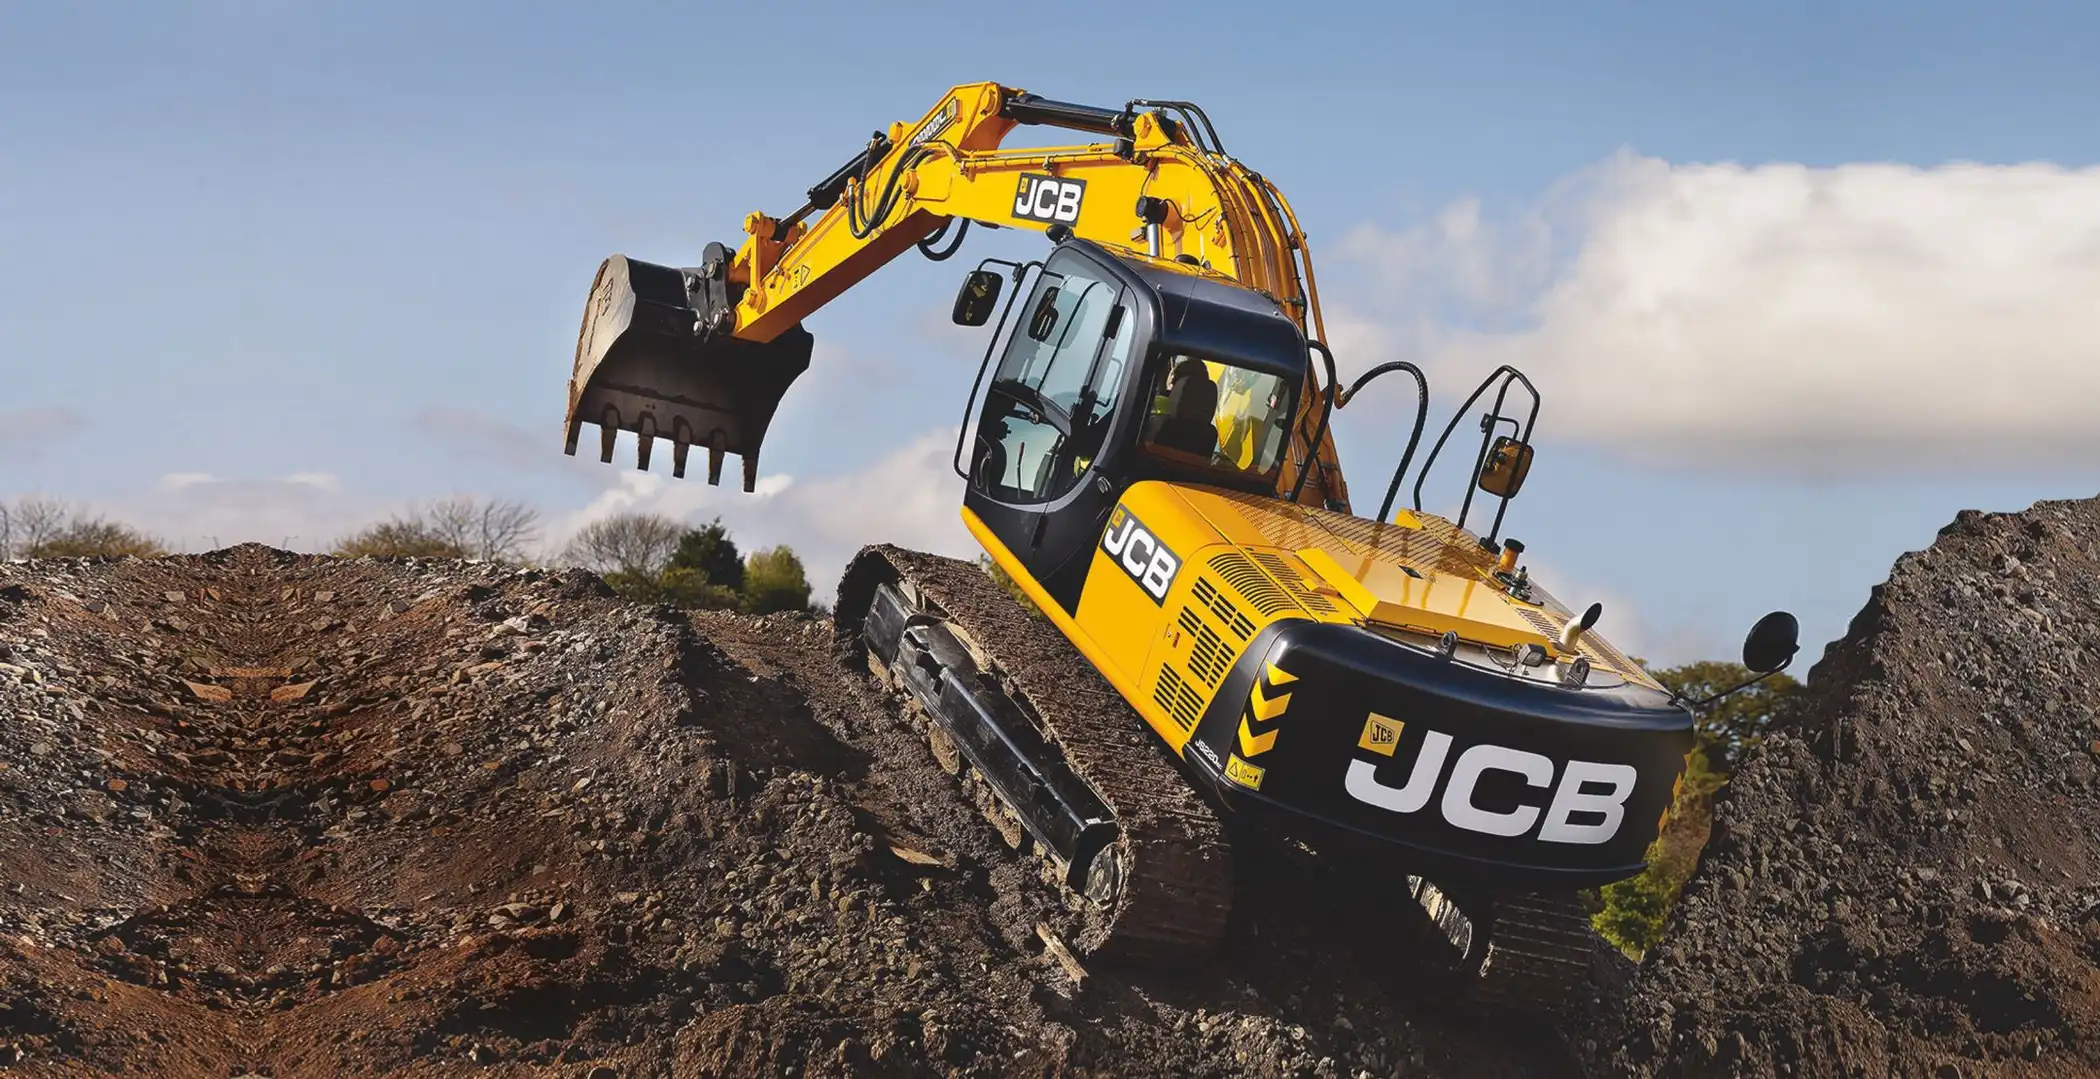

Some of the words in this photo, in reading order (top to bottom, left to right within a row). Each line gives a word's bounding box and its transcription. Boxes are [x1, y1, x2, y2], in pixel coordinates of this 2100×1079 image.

[1015, 178, 1082, 222] JCB
[1104, 518, 1177, 599] JCB
[1372, 724, 1393, 742] JCB
[1345, 730, 1637, 845] JCB
